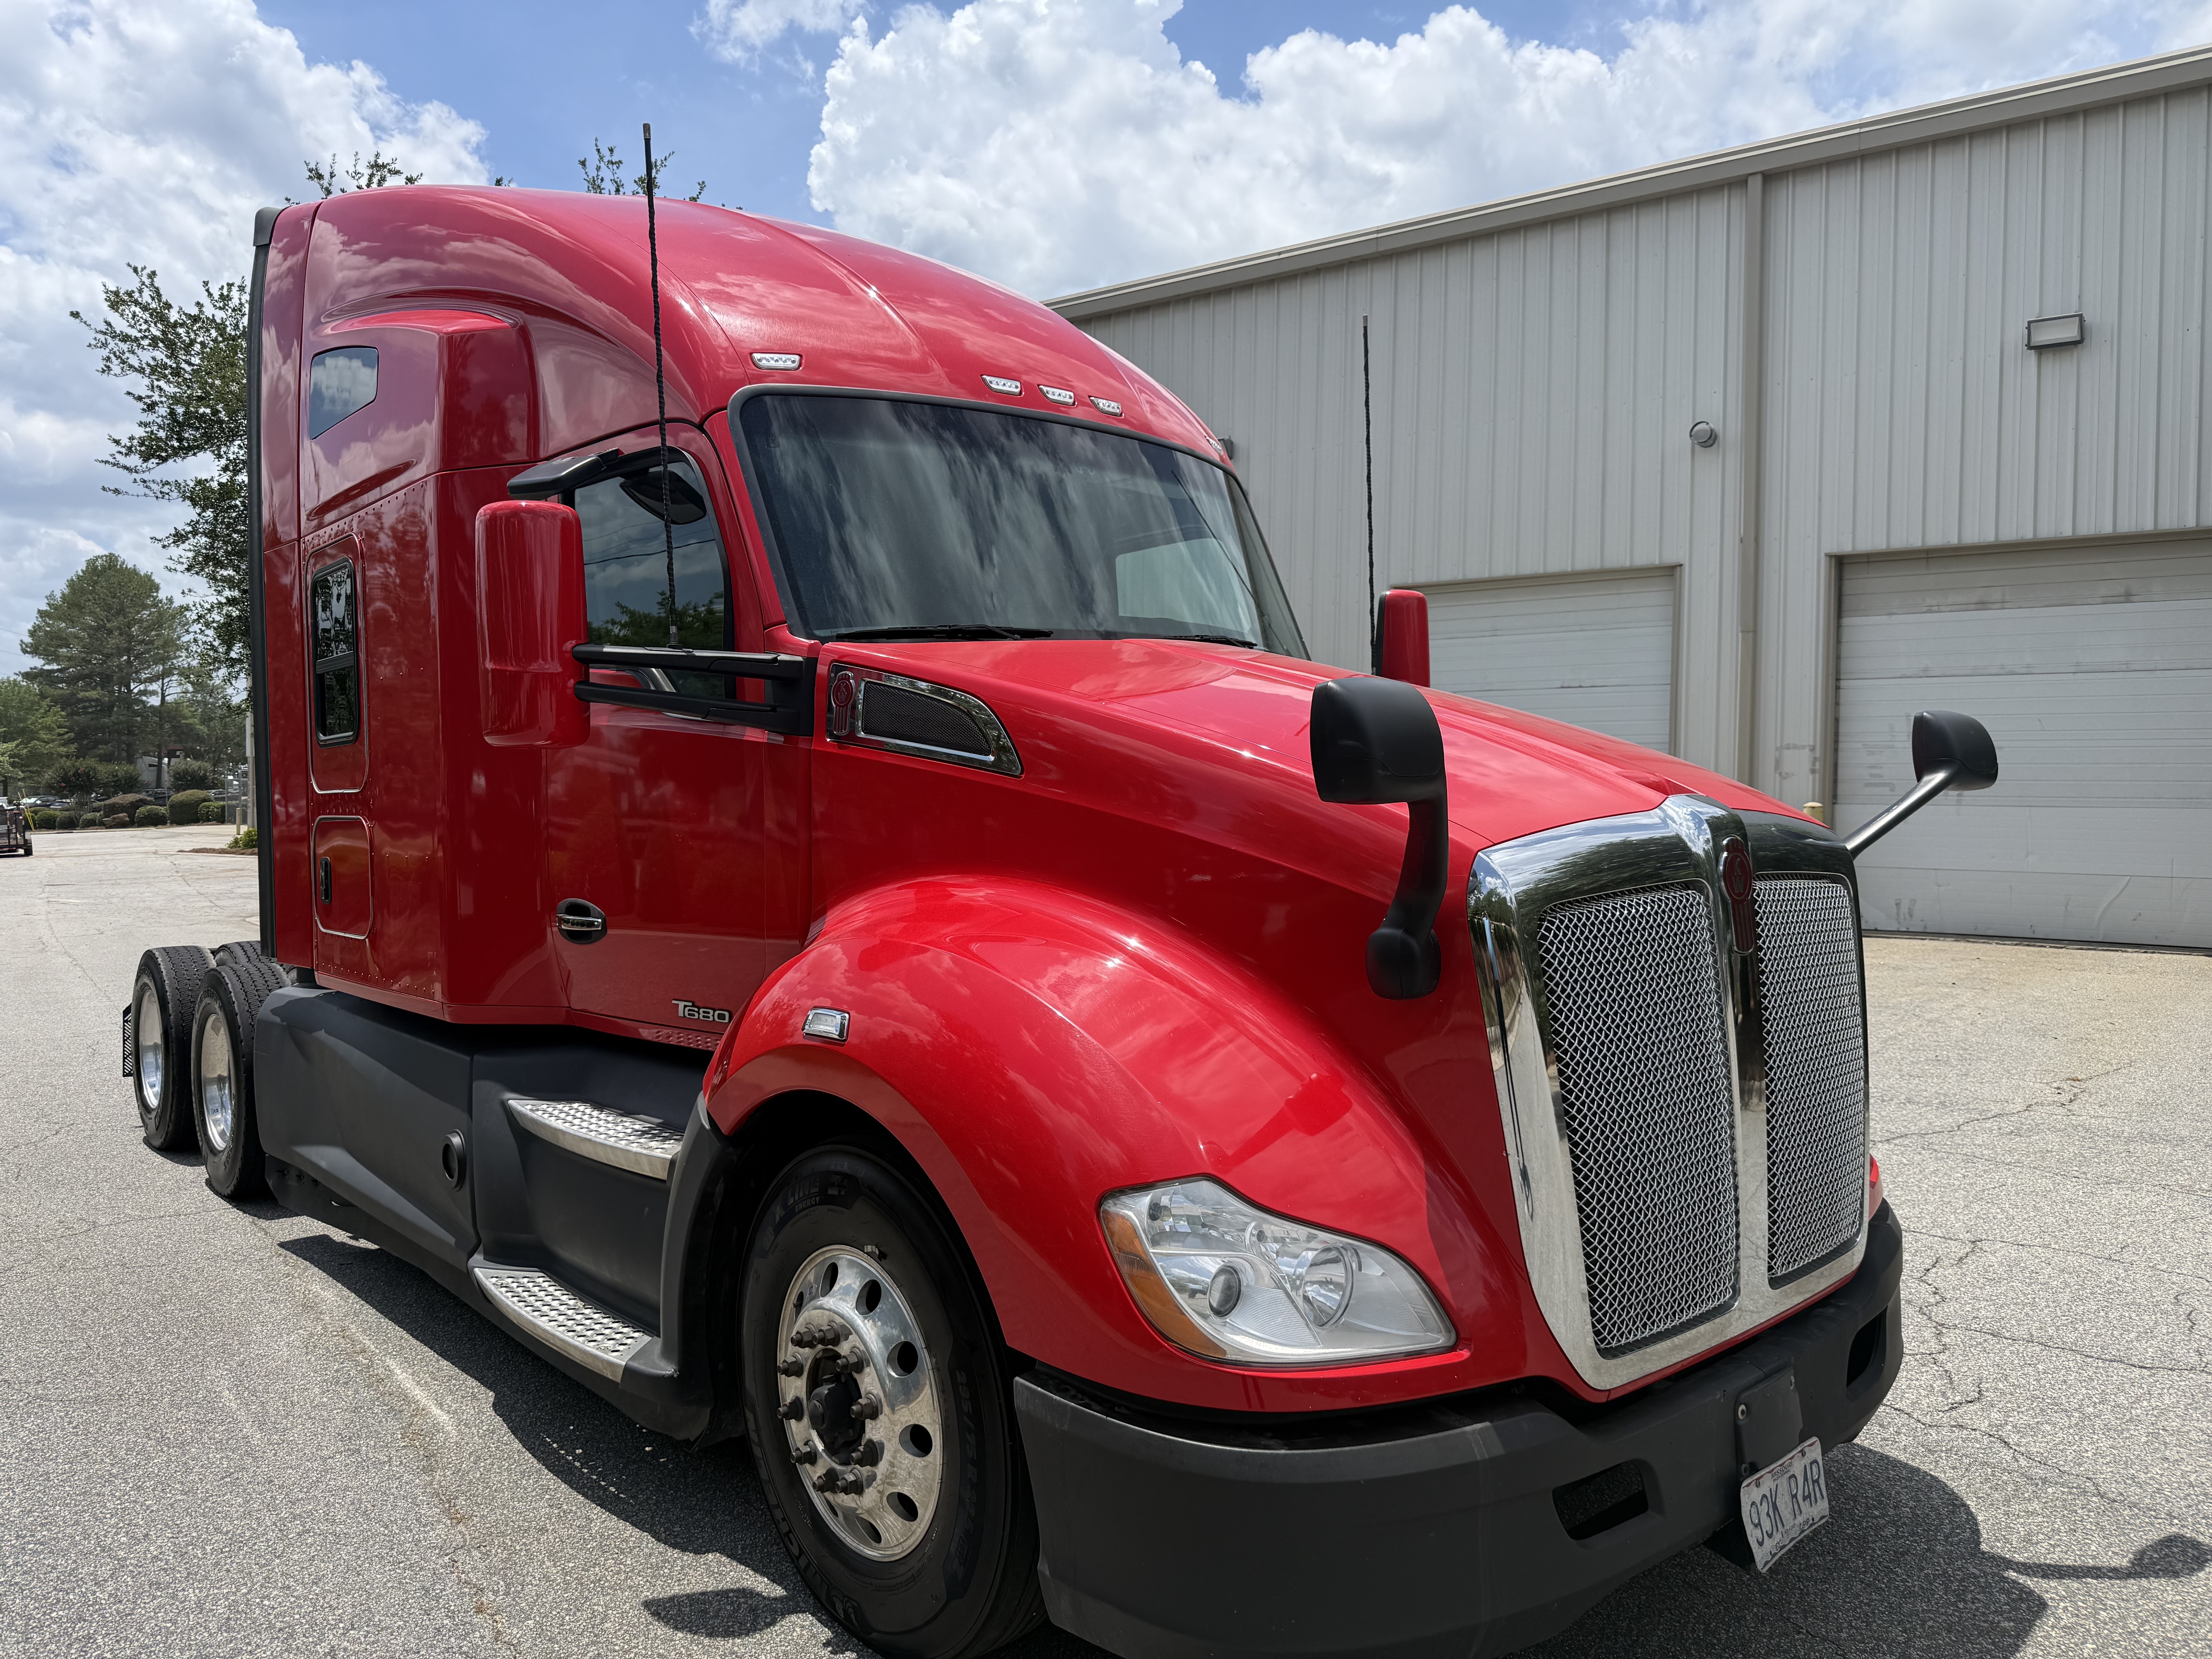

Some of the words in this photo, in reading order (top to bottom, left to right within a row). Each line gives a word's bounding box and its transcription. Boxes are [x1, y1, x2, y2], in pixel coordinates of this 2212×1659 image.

[672, 1000, 729, 1023] T680
[795, 1196, 821, 1212] ENERGY
[955, 1370, 977, 1460] 295/75
[1771, 1460, 1793, 1479] MISSOURI
[1749, 1483, 1784, 1547] 93K
[1788, 1459, 1824, 1519] R4R
